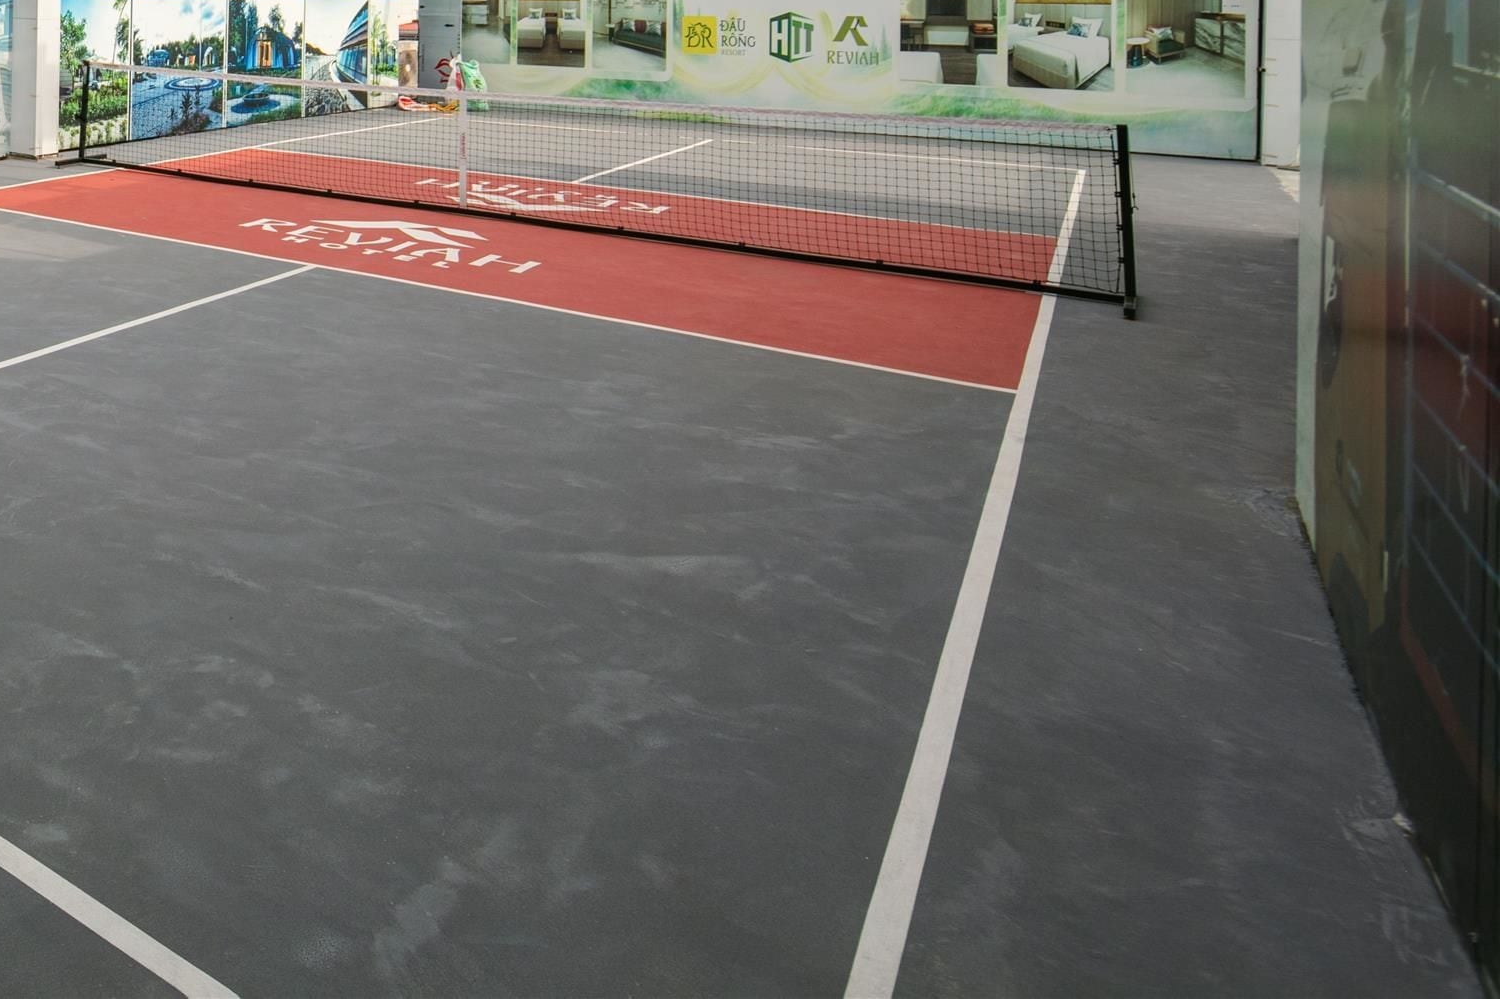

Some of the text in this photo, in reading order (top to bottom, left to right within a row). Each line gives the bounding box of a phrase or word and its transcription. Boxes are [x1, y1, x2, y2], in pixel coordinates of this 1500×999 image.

[771, 18, 814, 55] HTT
[827, 50, 879, 65] REVIAH
[238, 217, 543, 274] REVIAH
[280, 235, 451, 269] HOTEL
